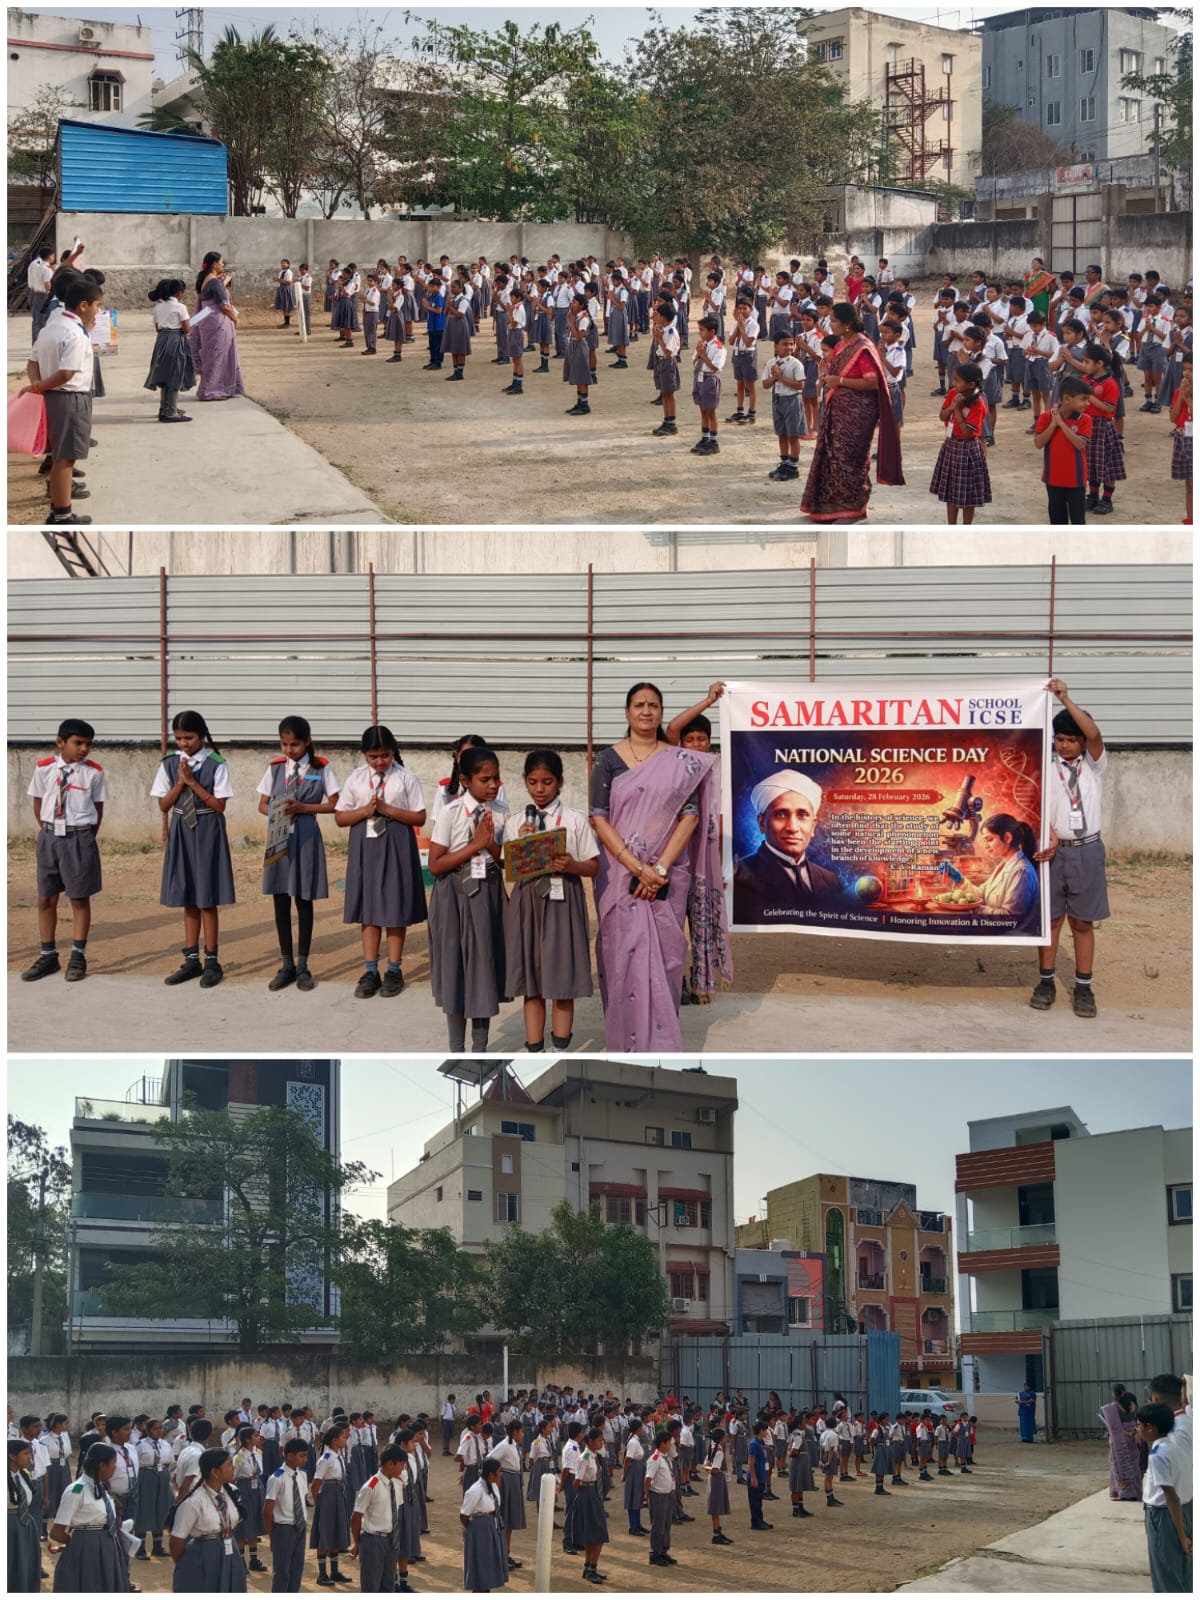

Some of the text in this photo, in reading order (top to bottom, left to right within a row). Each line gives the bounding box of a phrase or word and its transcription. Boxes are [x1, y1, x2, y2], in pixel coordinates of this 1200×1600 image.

[968, 698, 1022, 709] SCHOOL
[751, 699, 964, 727] SAMARITAN
[968, 709, 1022, 724] ICSE
[774, 747, 989, 763] NATIONAL SCIENCE DAY
[854, 768, 904, 784] 2026
[833, 793, 865, 801] Saturday,
[879, 793, 910, 801] February
[763, 908, 879, 922] Celebrating the Spirit of Science
[890, 916, 928, 926] Honoring
[928, 917, 971, 926] Innovation
[980, 919, 1018, 928] Discovery
